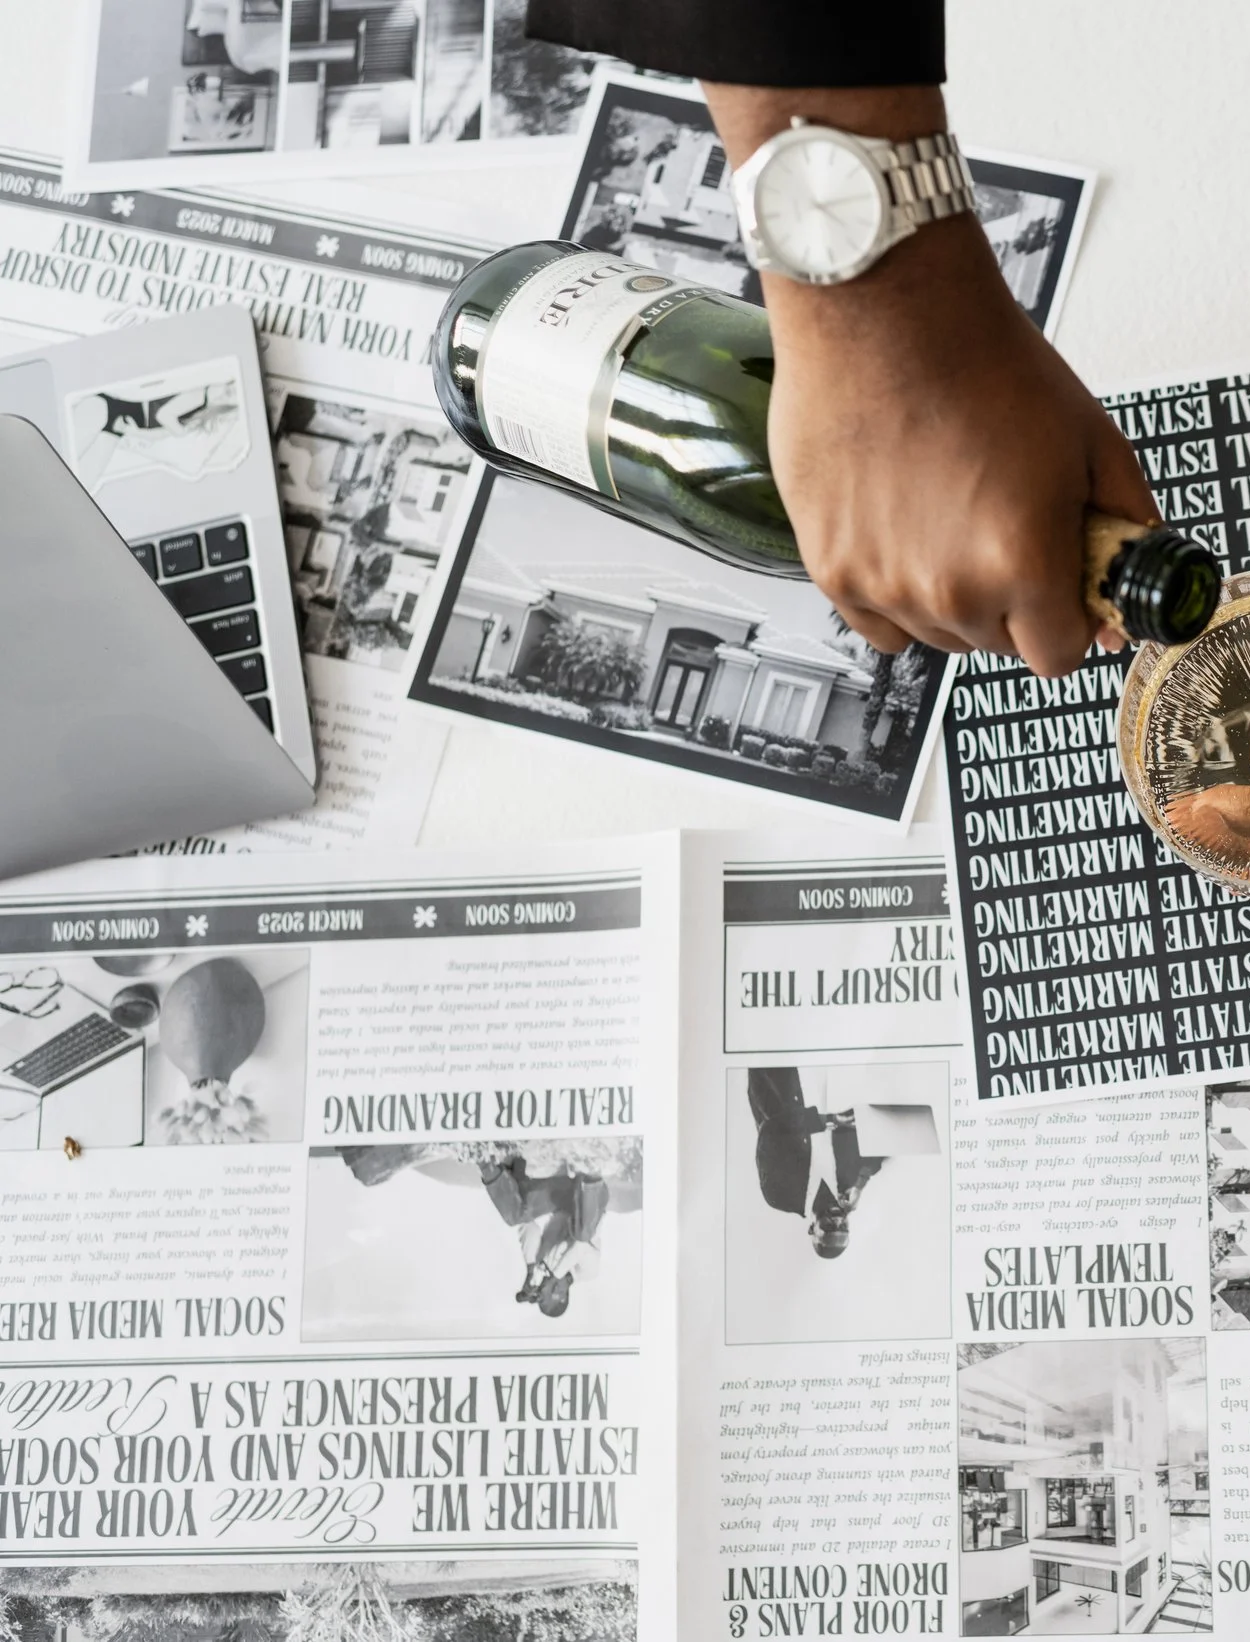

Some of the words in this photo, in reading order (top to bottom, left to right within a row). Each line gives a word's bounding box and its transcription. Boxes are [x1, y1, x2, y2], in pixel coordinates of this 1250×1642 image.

[177, 208, 222, 232] 2025
[223, 216, 275, 245] MARCH
[52, 222, 186, 277] INDUSTRY
[360, 244, 404, 269] SOON
[193, 250, 289, 298] ESTATE
[407, 252, 464, 282] COMING
[518, 269, 534, 285] AND
[95, 273, 132, 303] TO
[296, 271, 366, 312] REAL
[495, 287, 517, 316] CITRUS
[342, 316, 413, 360] YORK
[1105, 395, 1212, 442] ESTATE
[953, 665, 1124, 721] MARKETING
[969, 835, 1144, 890] MARKETING
[514, 901, 576, 923] COMING
[798, 888, 845, 910] SOON
[850, 886, 913, 908] COMING
[99, 917, 159, 939] COMING
[258, 911, 305, 934] 2025
[308, 908, 364, 930] MARCH
[465, 903, 510, 926] SOON
[51, 920, 95, 941] SOON
[978, 919, 1153, 977] MARKETING
[741, 971, 801, 1008] THE
[811, 965, 942, 1006] DISRUPT
[982, 965, 1159, 1023] MARKETING
[986, 1010, 1164, 1068] MARKETING
[989, 1052, 1169, 1097] MARKETING
[323, 1090, 482, 1134] BRANDING
[495, 1085, 634, 1129] REALTOR
[970, 1199, 1010, 1213] agents
[1011, 1200, 1046, 1212] estate
[1047, 1199, 1072, 1214] real
[1074, 1195, 1093, 1213] for
[1094, 1196, 1143, 1213] tailored
[1144, 1191, 1203, 1210] templates
[954, 1219, 1022, 1235] easy-to-use
[1041, 1215, 1120, 1235] eye-catching,
[1138, 1214, 1178, 1232] design
[984, 1242, 1173, 1287] TEMPLATES
[68, 1298, 164, 1339] MEDIA
[174, 1295, 285, 1337] SOCIAL
[965, 1290, 1065, 1332] MEDIA
[1077, 1285, 1194, 1328] SOCIAL
[190, 1381, 212, 1429] A
[224, 1380, 269, 1428] AS
[282, 1375, 477, 1426] PRESENCE
[492, 1373, 609, 1422] MEDIA
[113, 1434, 213, 1484] YOUR
[229, 1432, 305, 1482] AND
[317, 1429, 489, 1480] LISTINGS
[503, 1425, 640, 1476] ESTATE
[719, 1468, 771, 1488] footage,
[773, 1470, 813, 1486] drone
[815, 1466, 873, 1485] stunning
[876, 1468, 906, 1484] with
[908, 1467, 952, 1483] Paired
[93, 1487, 199, 1539] YOUR
[209, 1480, 383, 1544] Elevate
[411, 1483, 469, 1533] WE
[484, 1480, 619, 1531] WHERE
[718, 1515, 762, 1535] buyers
[771, 1515, 800, 1534] help
[809, 1517, 838, 1532] that
[846, 1512, 883, 1531] plans
[891, 1511, 924, 1531] floor
[718, 1542, 786, 1559] immersive
[790, 1541, 817, 1557] and
[846, 1539, 899, 1555] detailed
[901, 1538, 942, 1550] create
[722, 1564, 847, 1601] CONTENT
[856, 1562, 948, 1597] DRONE
[728, 1604, 749, 1639] &
[758, 1601, 843, 1637] PLANS
[853, 1599, 943, 1634] FLOOR
